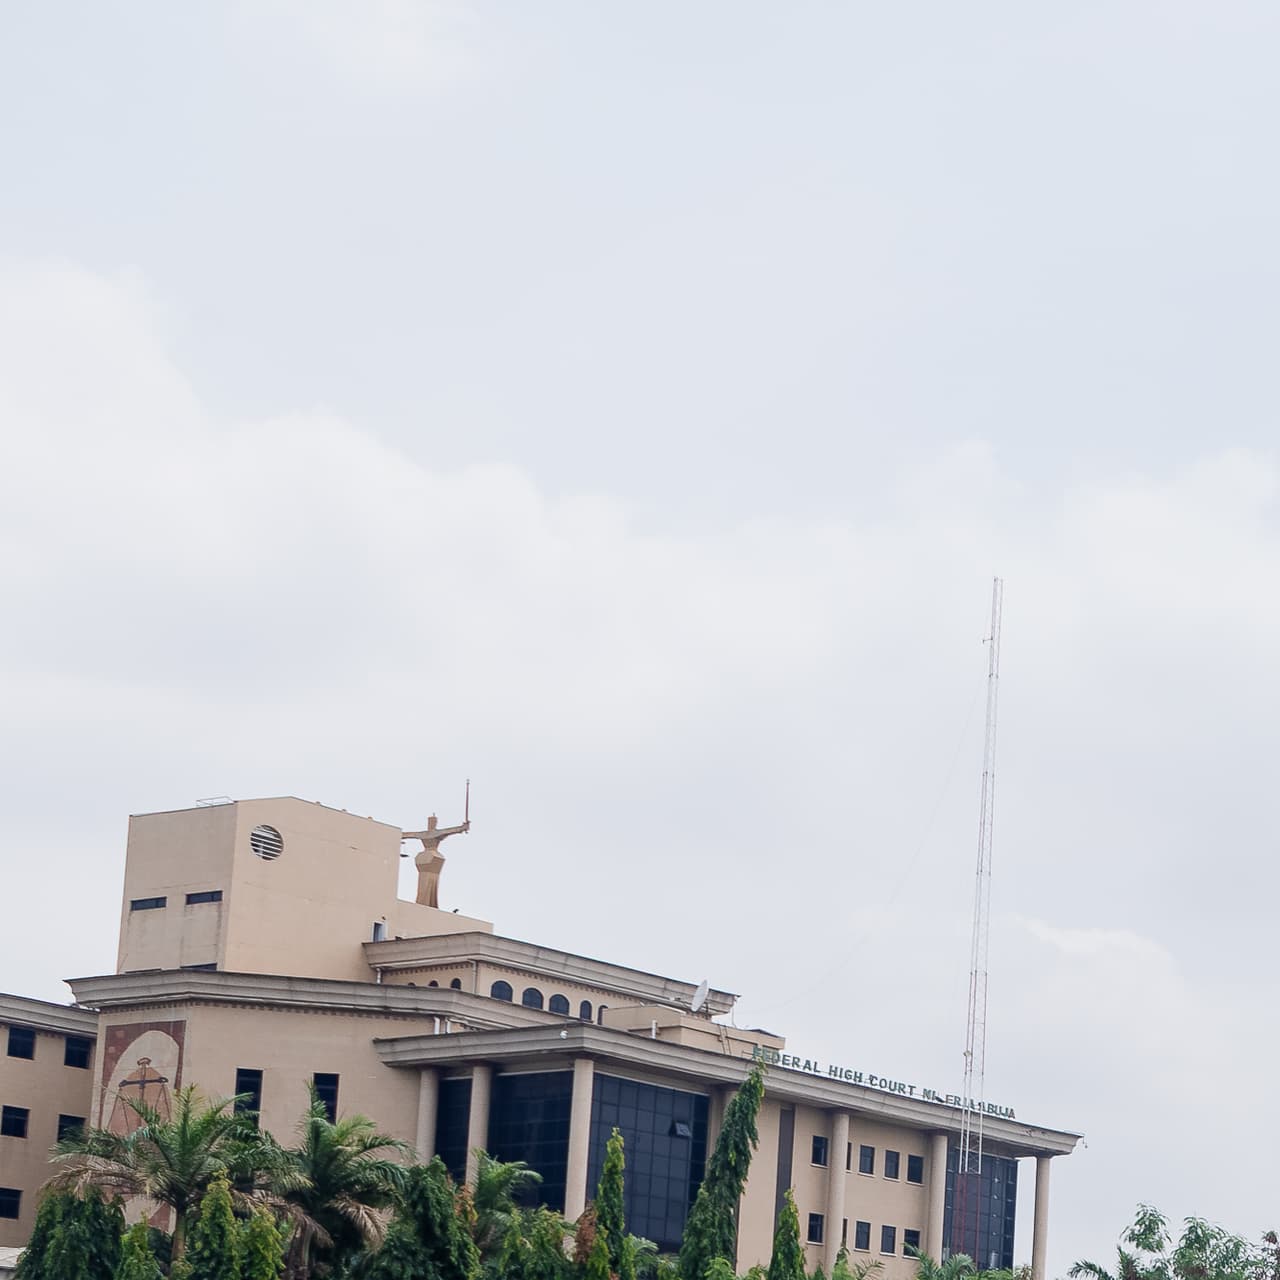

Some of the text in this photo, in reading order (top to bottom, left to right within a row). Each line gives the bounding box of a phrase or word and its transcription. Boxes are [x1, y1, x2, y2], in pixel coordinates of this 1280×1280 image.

[752, 1046, 821, 1073] FEDERAL
[829, 1064, 863, 1083] HIGH
[868, 1074, 916, 1096] COURT
[922, 1087, 975, 1109] NIERIA
